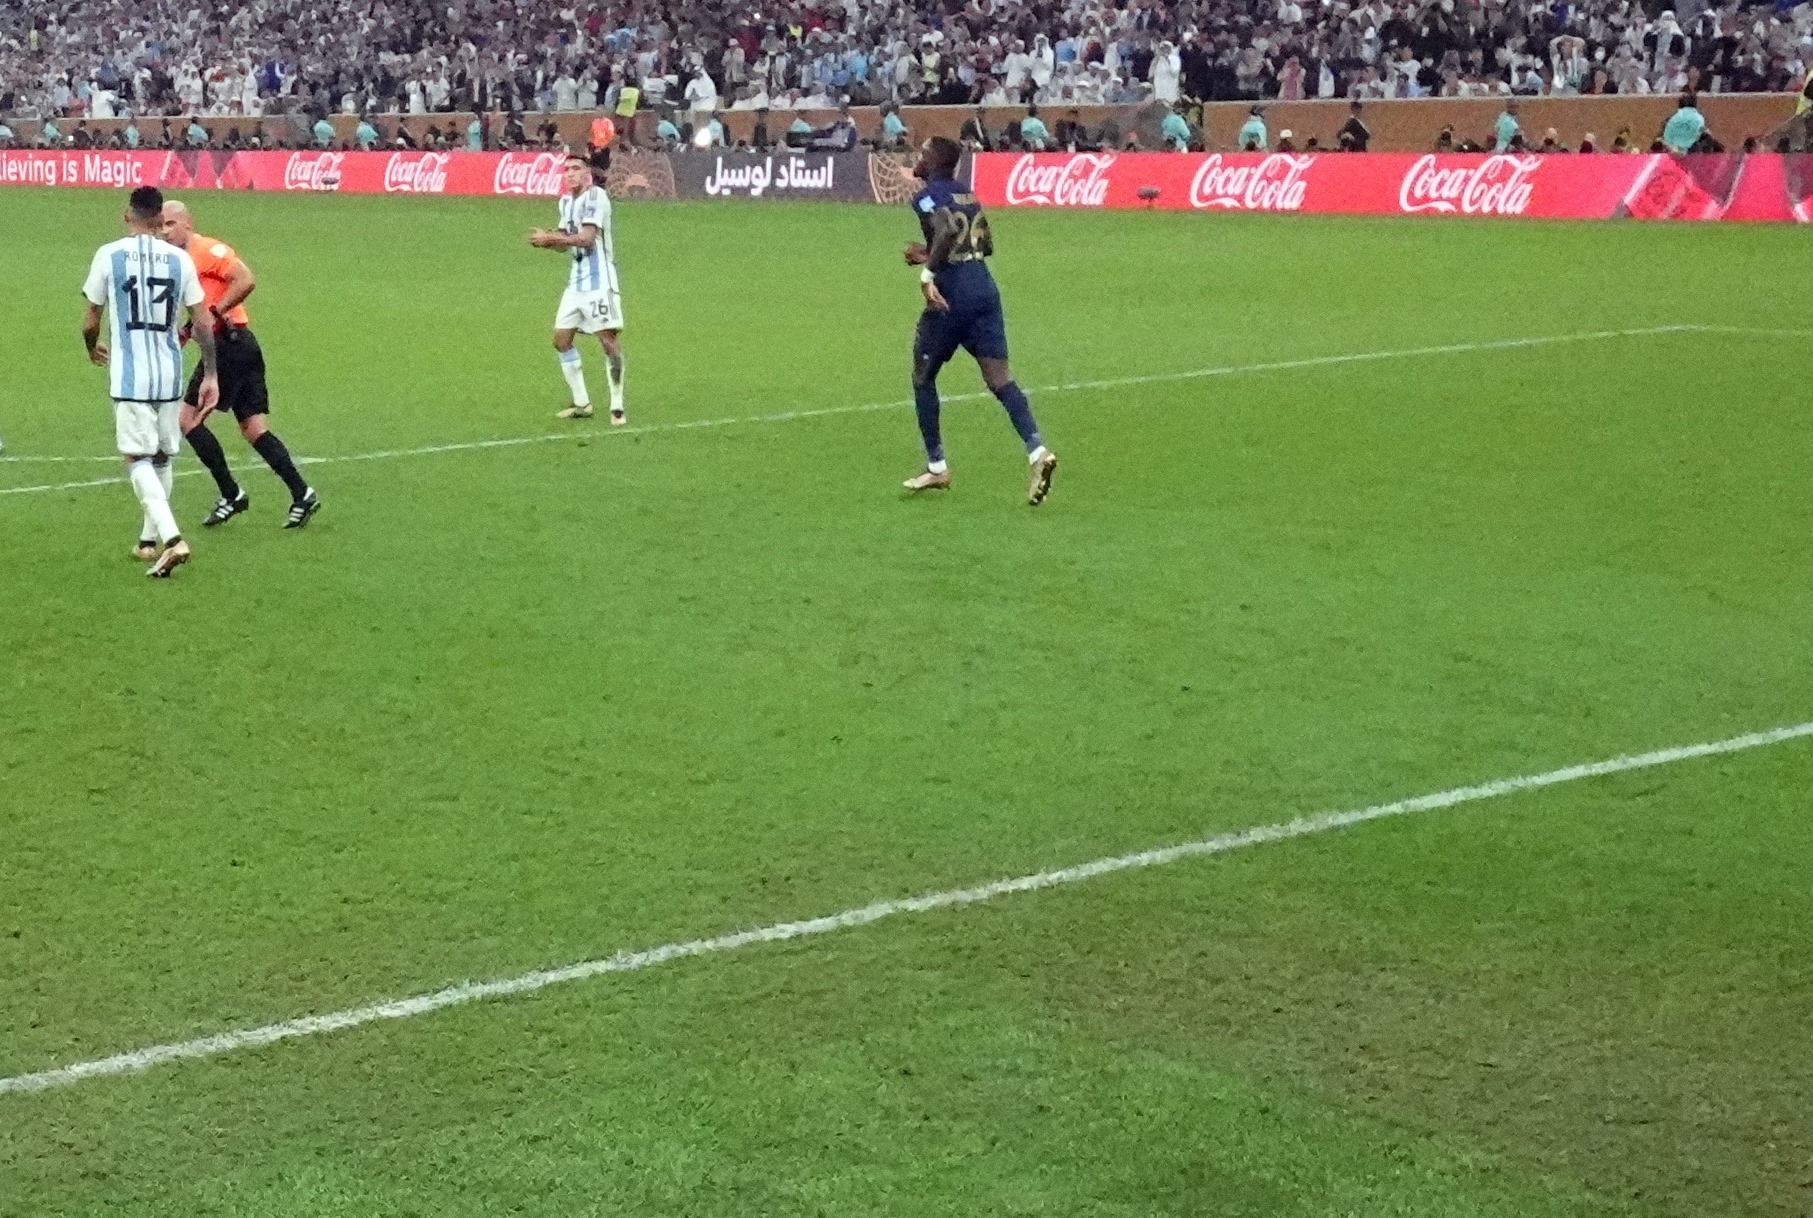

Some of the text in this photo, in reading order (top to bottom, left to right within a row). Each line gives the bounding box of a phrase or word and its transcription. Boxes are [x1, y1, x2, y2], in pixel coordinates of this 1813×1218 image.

[62, 153, 79, 183] is
[84, 153, 143, 187] Magic
[705, 156, 834, 195] استاد لوسيل
[124, 250, 170, 265] ROMERO
[122, 275, 175, 331] 13
